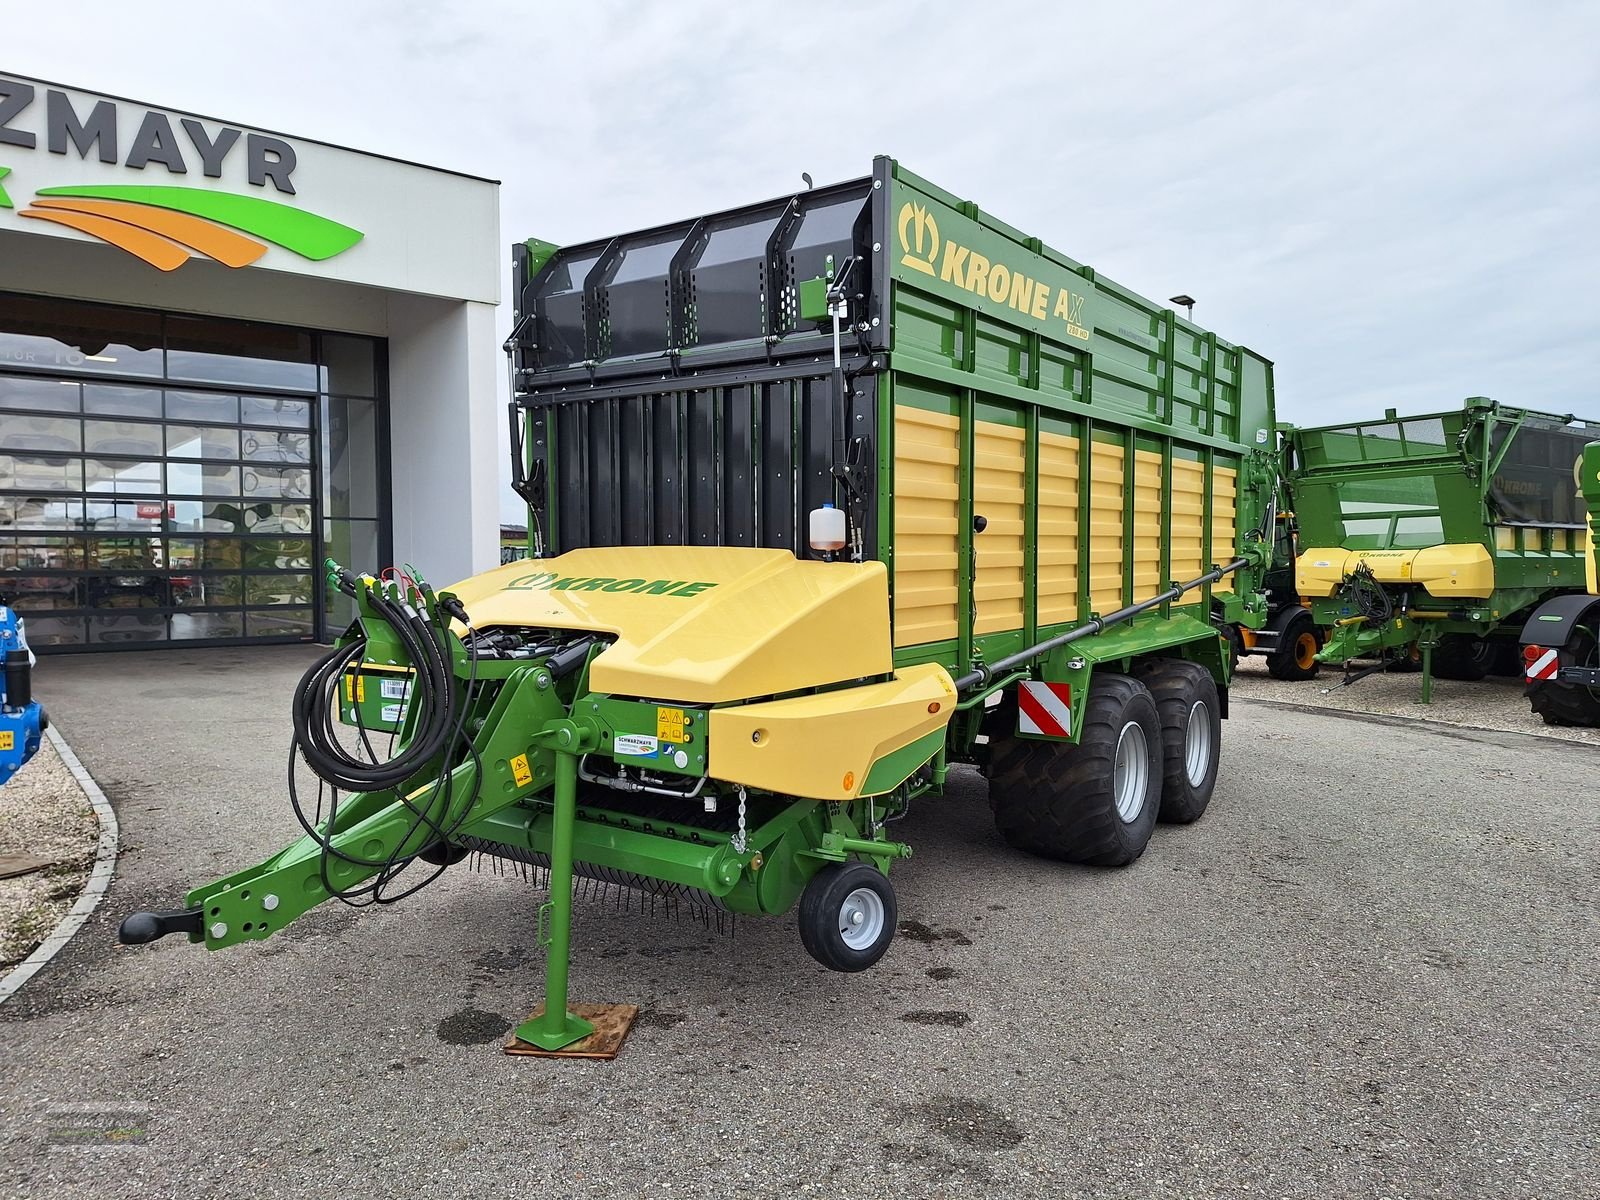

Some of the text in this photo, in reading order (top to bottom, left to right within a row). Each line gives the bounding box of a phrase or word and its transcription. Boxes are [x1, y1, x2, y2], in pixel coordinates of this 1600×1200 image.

[0, 79, 298, 195] ZMAYR
[940, 239, 1085, 326] KRONE AX
[1068, 324, 1079, 336] 280
[1503, 480, 1543, 496] KRONE
[540, 577, 719, 597] KRONE
[618, 736, 652, 746] SCHWARZMAYR
